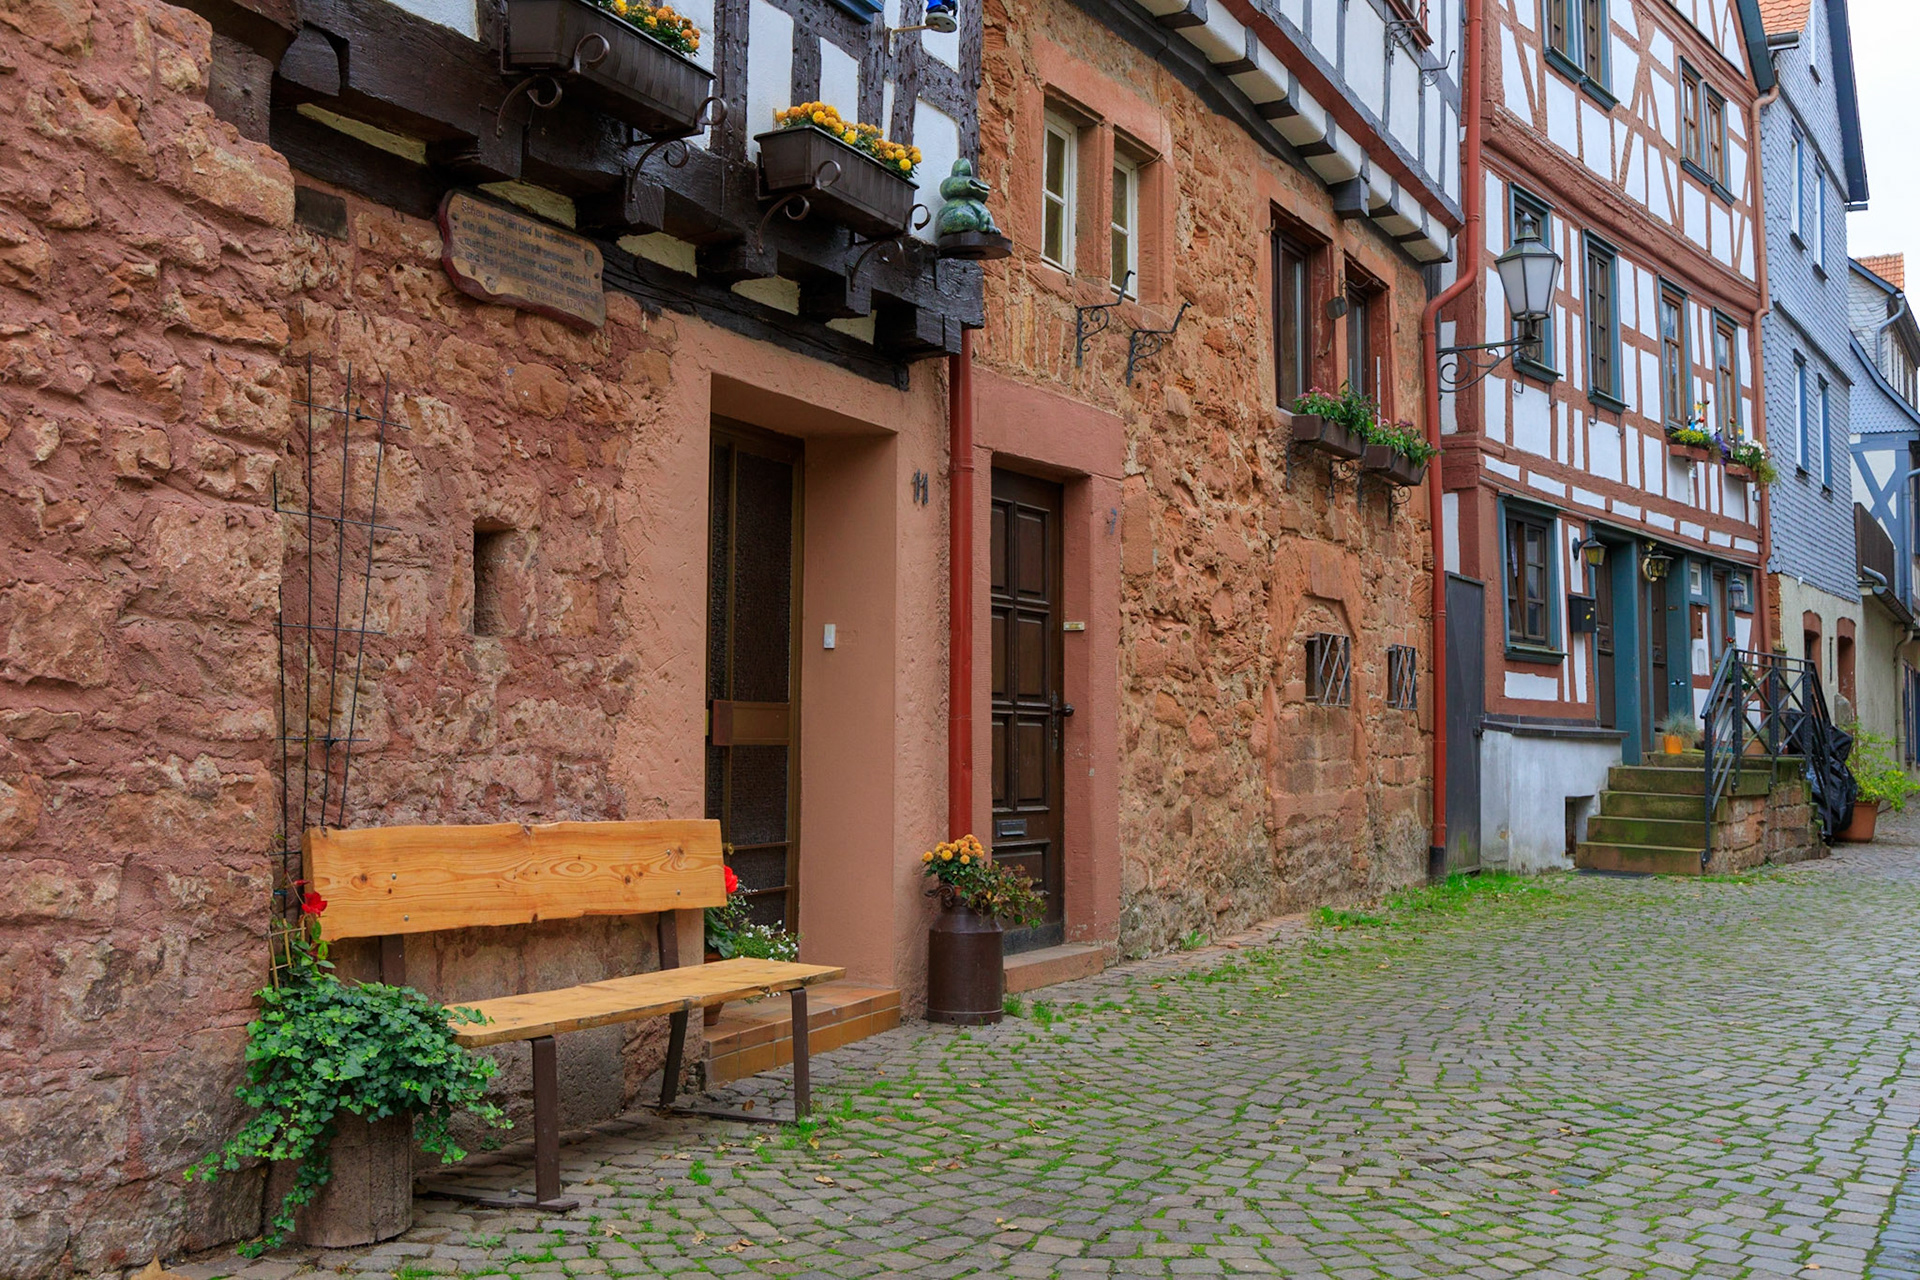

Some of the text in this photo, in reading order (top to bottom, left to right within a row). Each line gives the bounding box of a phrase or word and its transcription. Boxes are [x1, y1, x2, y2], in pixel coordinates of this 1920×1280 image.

[461, 201, 485, 218] Schau
[518, 223, 532, 235] und
[462, 220, 474, 231] ein
[465, 250, 479, 262] und
[912, 468, 930, 505] 11
